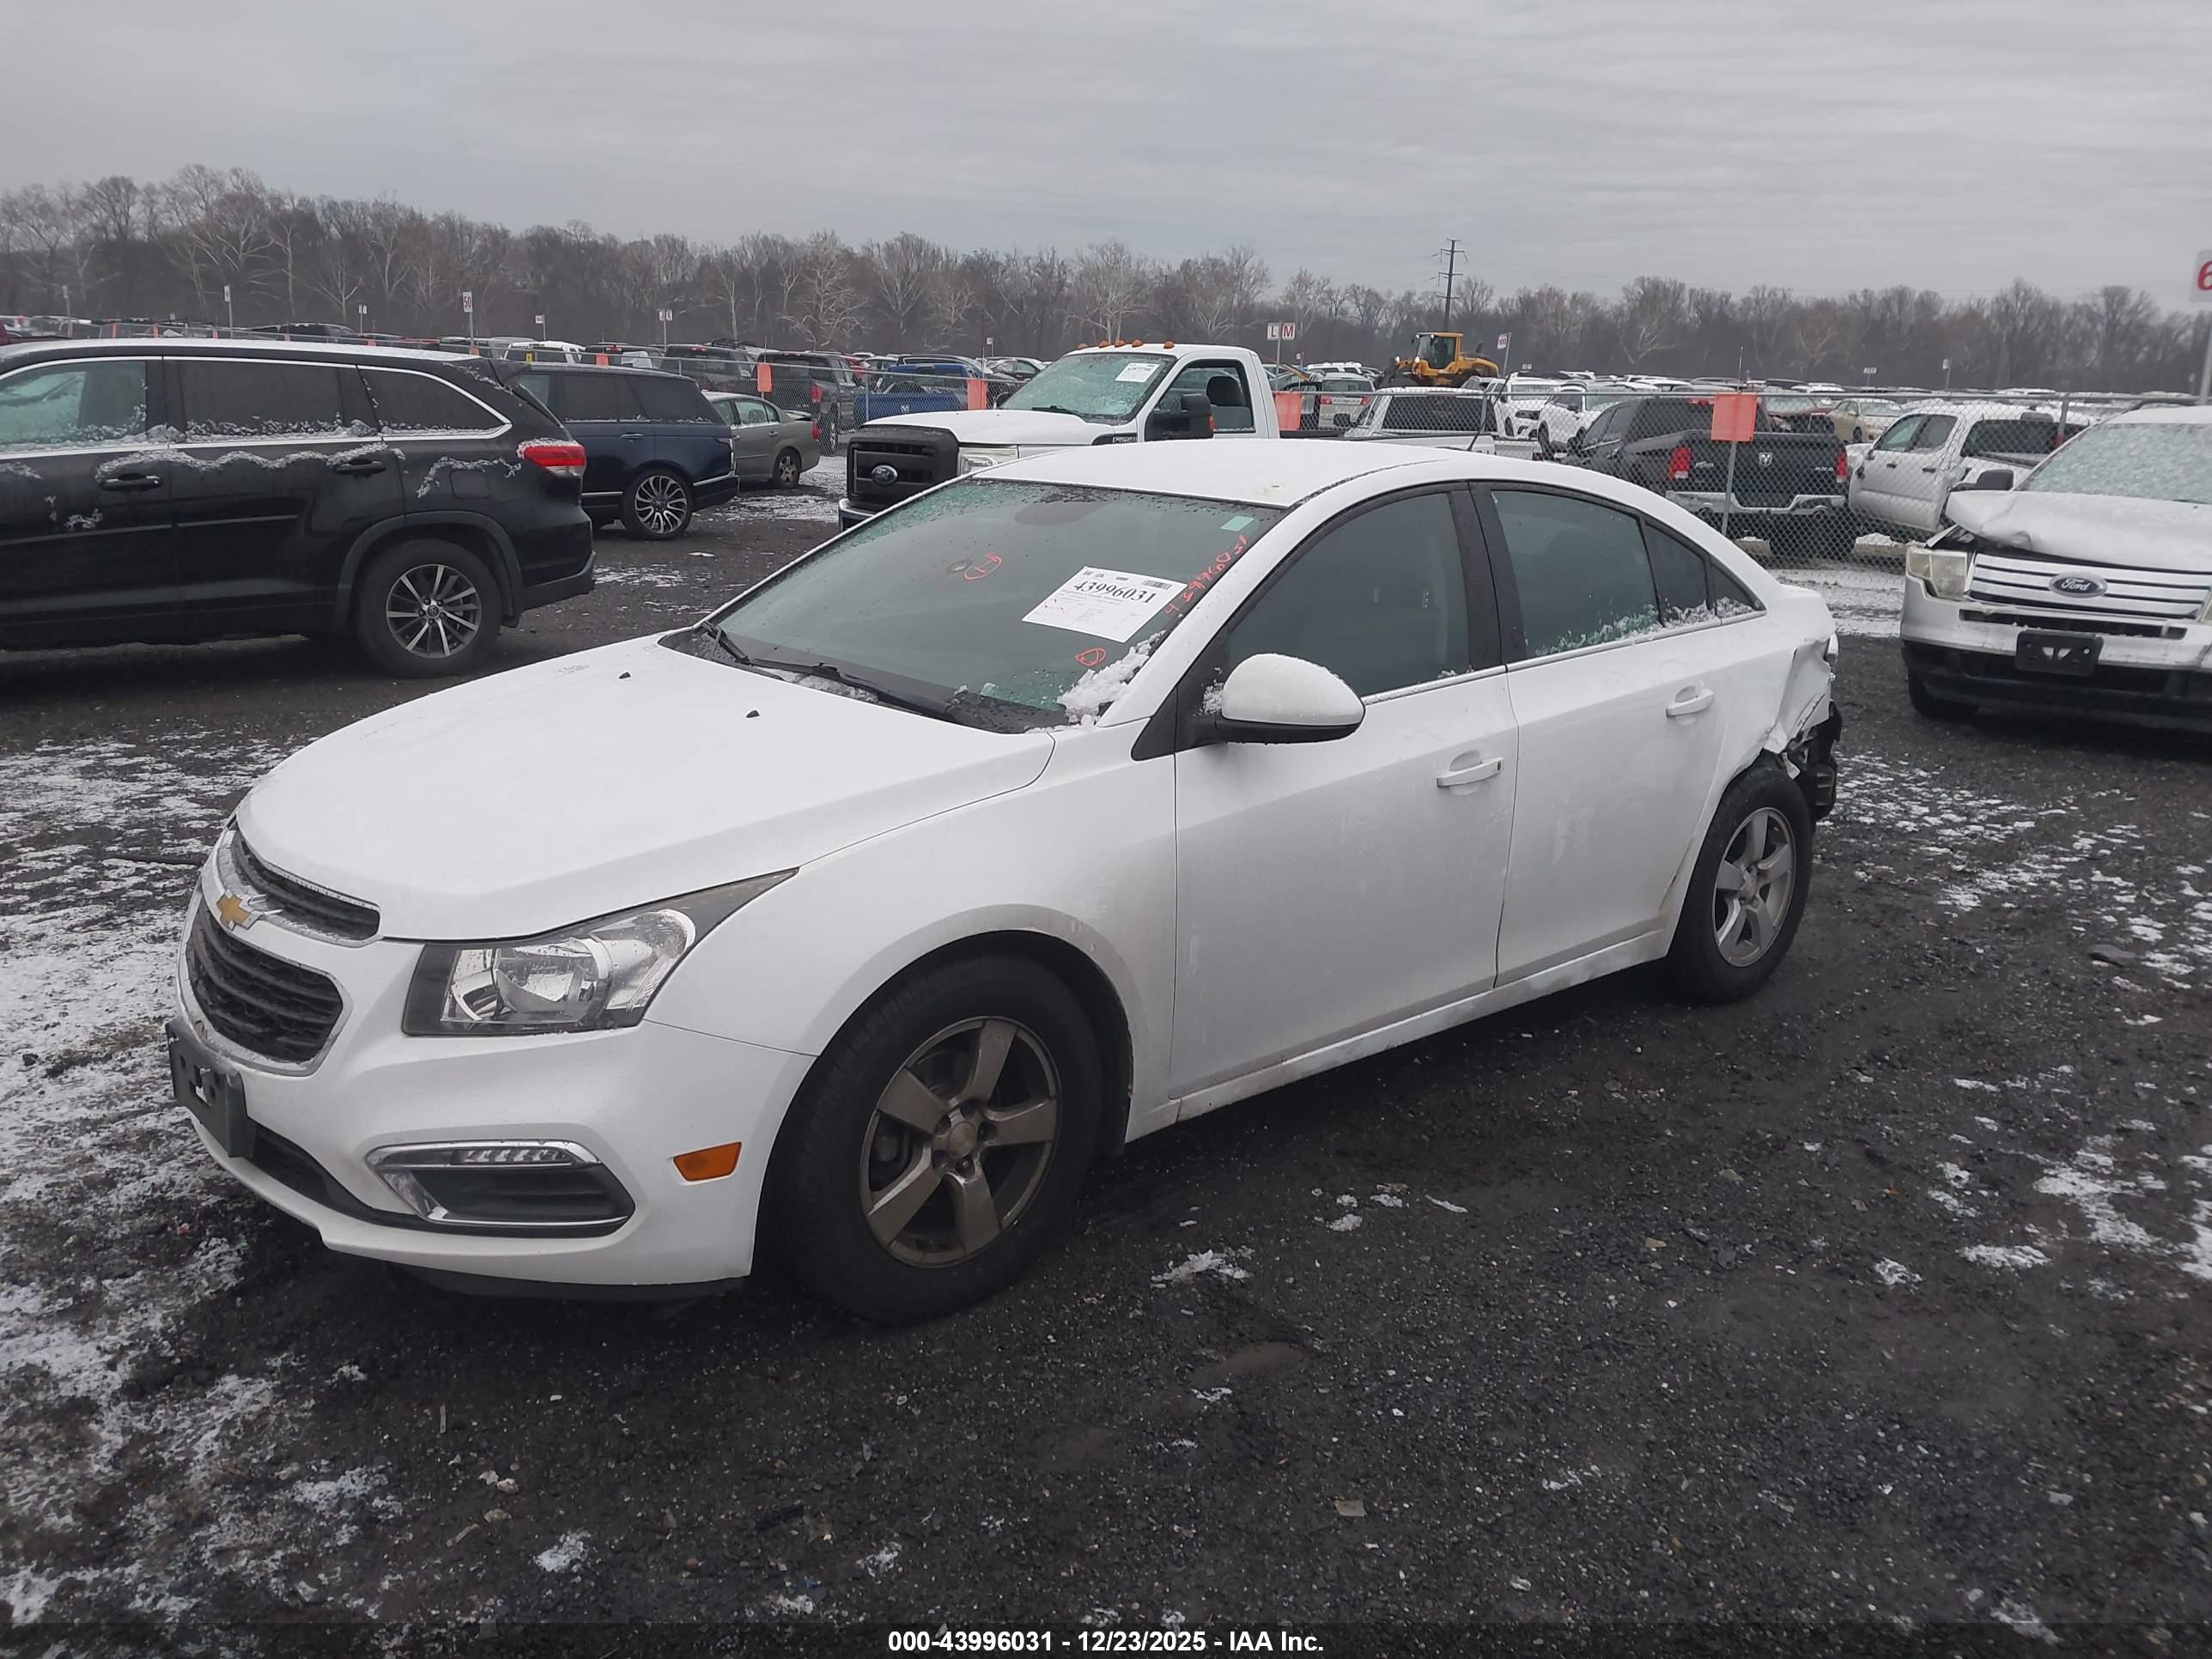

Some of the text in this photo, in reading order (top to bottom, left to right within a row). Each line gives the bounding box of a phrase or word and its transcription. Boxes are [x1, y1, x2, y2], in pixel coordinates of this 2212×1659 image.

[464, 296, 471, 308] 50
[1271, 325, 1277, 337] L
[1283, 325, 1293, 337] M
[2061, 577, 2091, 591] Ford
[1073, 580, 1158, 603] 43996031
